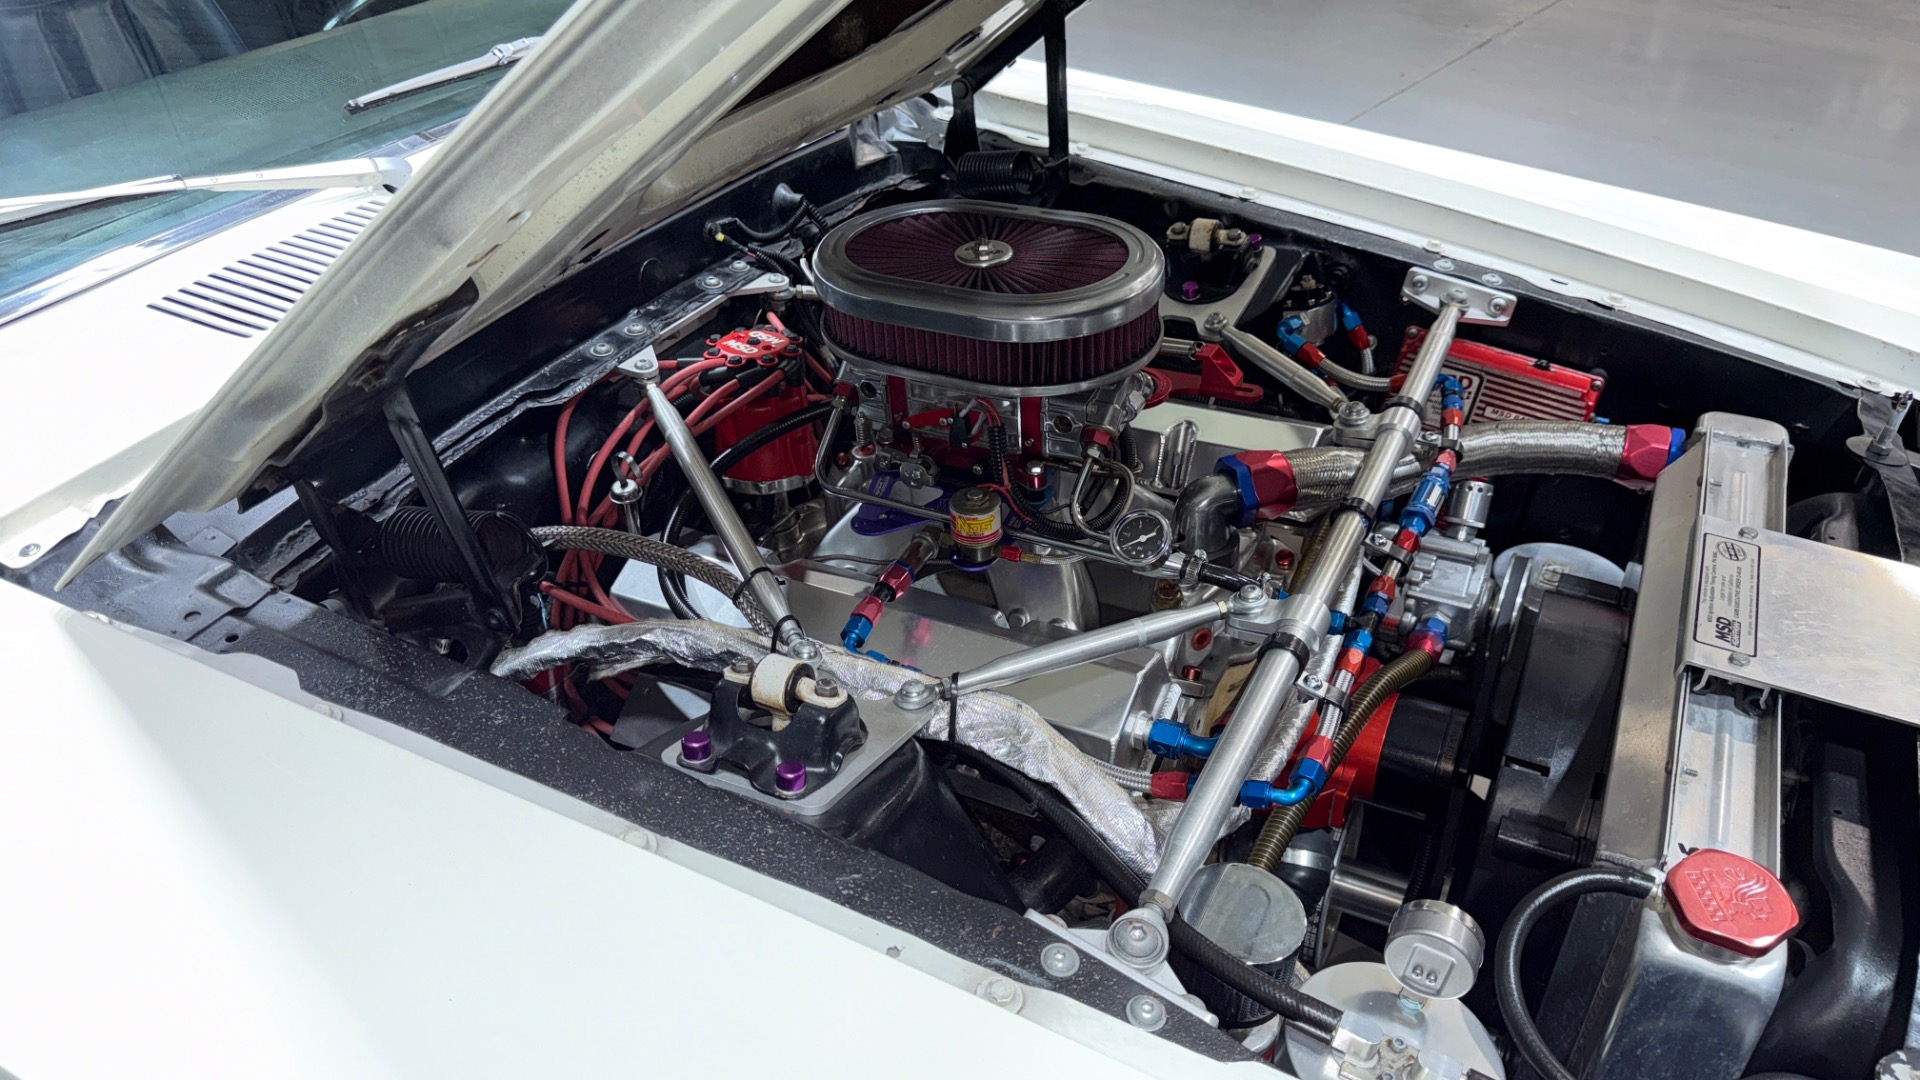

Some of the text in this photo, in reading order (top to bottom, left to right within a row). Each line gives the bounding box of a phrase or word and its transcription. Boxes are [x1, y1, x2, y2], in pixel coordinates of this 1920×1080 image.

[748, 331, 784, 344] MSD
[721, 340, 758, 353] MSD
[1490, 409, 1511, 418] MSD
[957, 515, 994, 534] NOS
[1715, 616, 1732, 643] MSD
